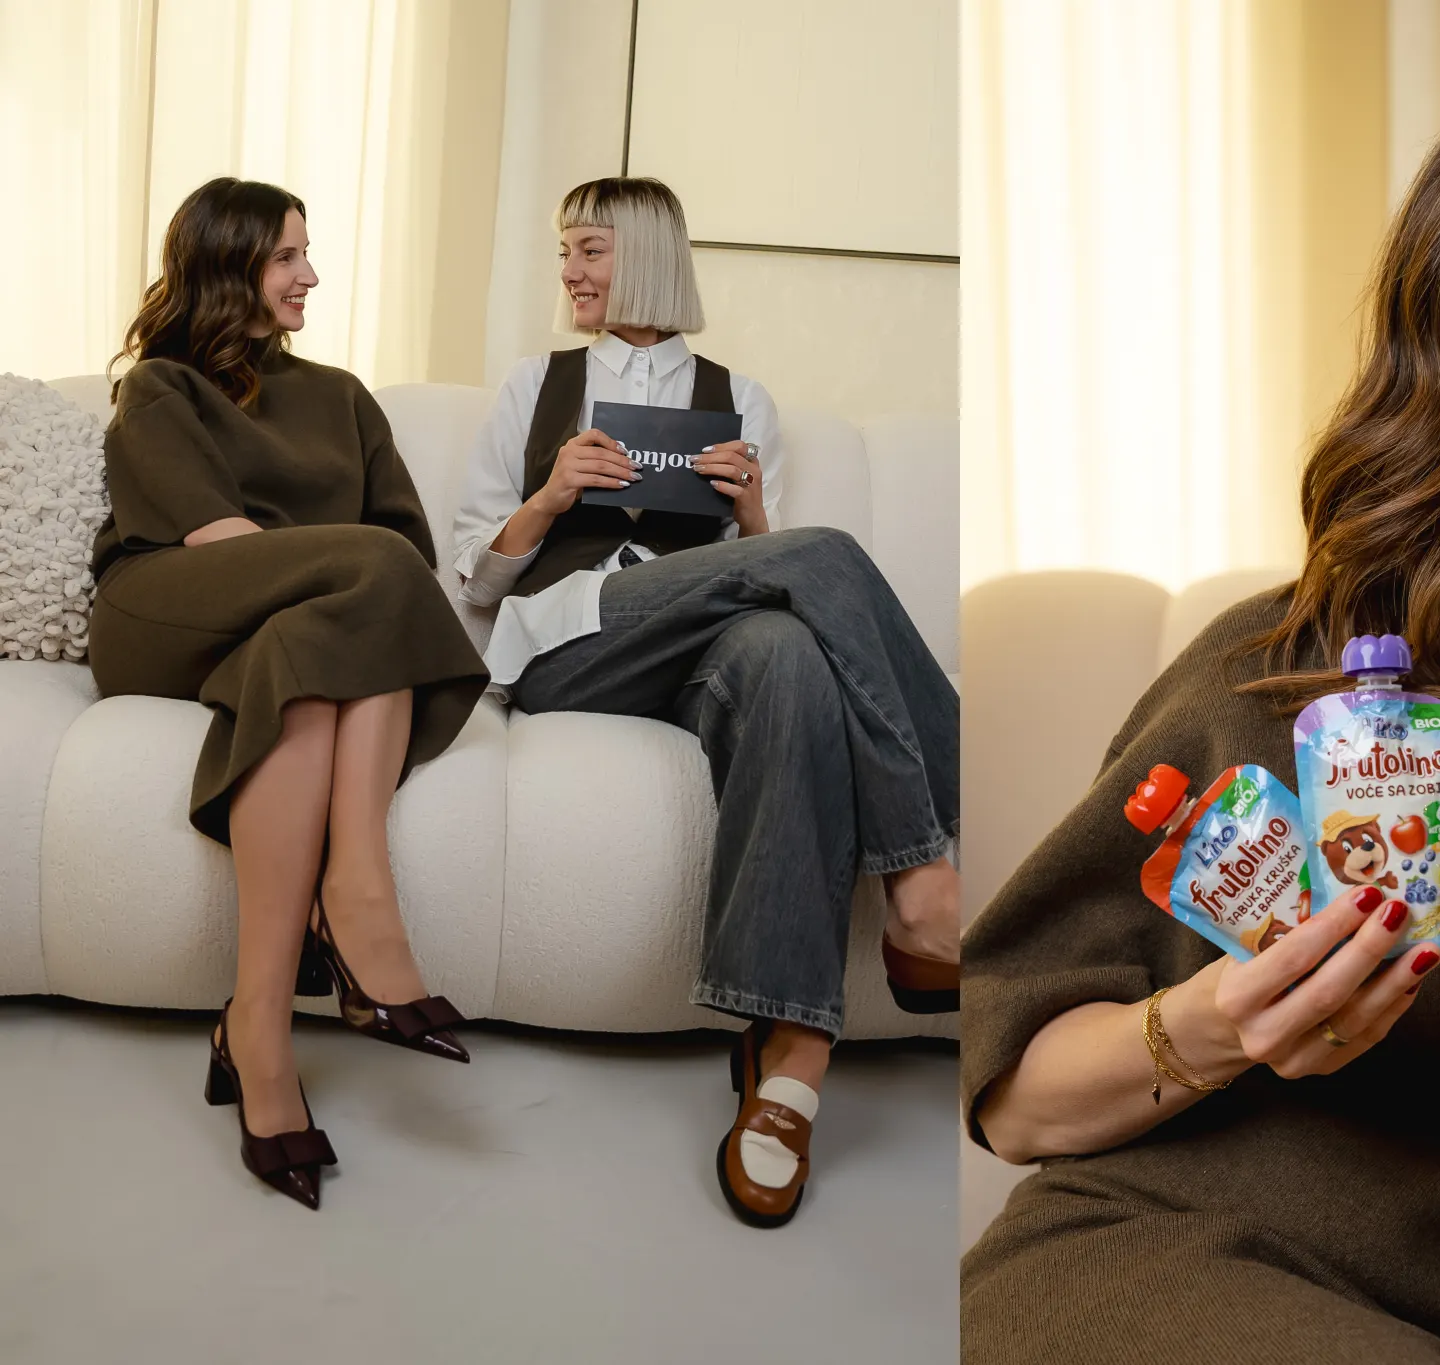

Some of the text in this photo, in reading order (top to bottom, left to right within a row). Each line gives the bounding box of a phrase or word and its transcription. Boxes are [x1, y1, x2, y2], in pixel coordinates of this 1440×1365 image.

[1232, 788, 1255, 817] BIO
[1346, 784, 1384, 799] VOĆE
[1388, 785, 1406, 797] SA
[1188, 816, 1291, 924] frutolino
[1195, 825, 1238, 869] Lino
[1226, 844, 1302, 927] JABUKA, KRUŠKA
[1250, 870, 1298, 921] I BANANA
